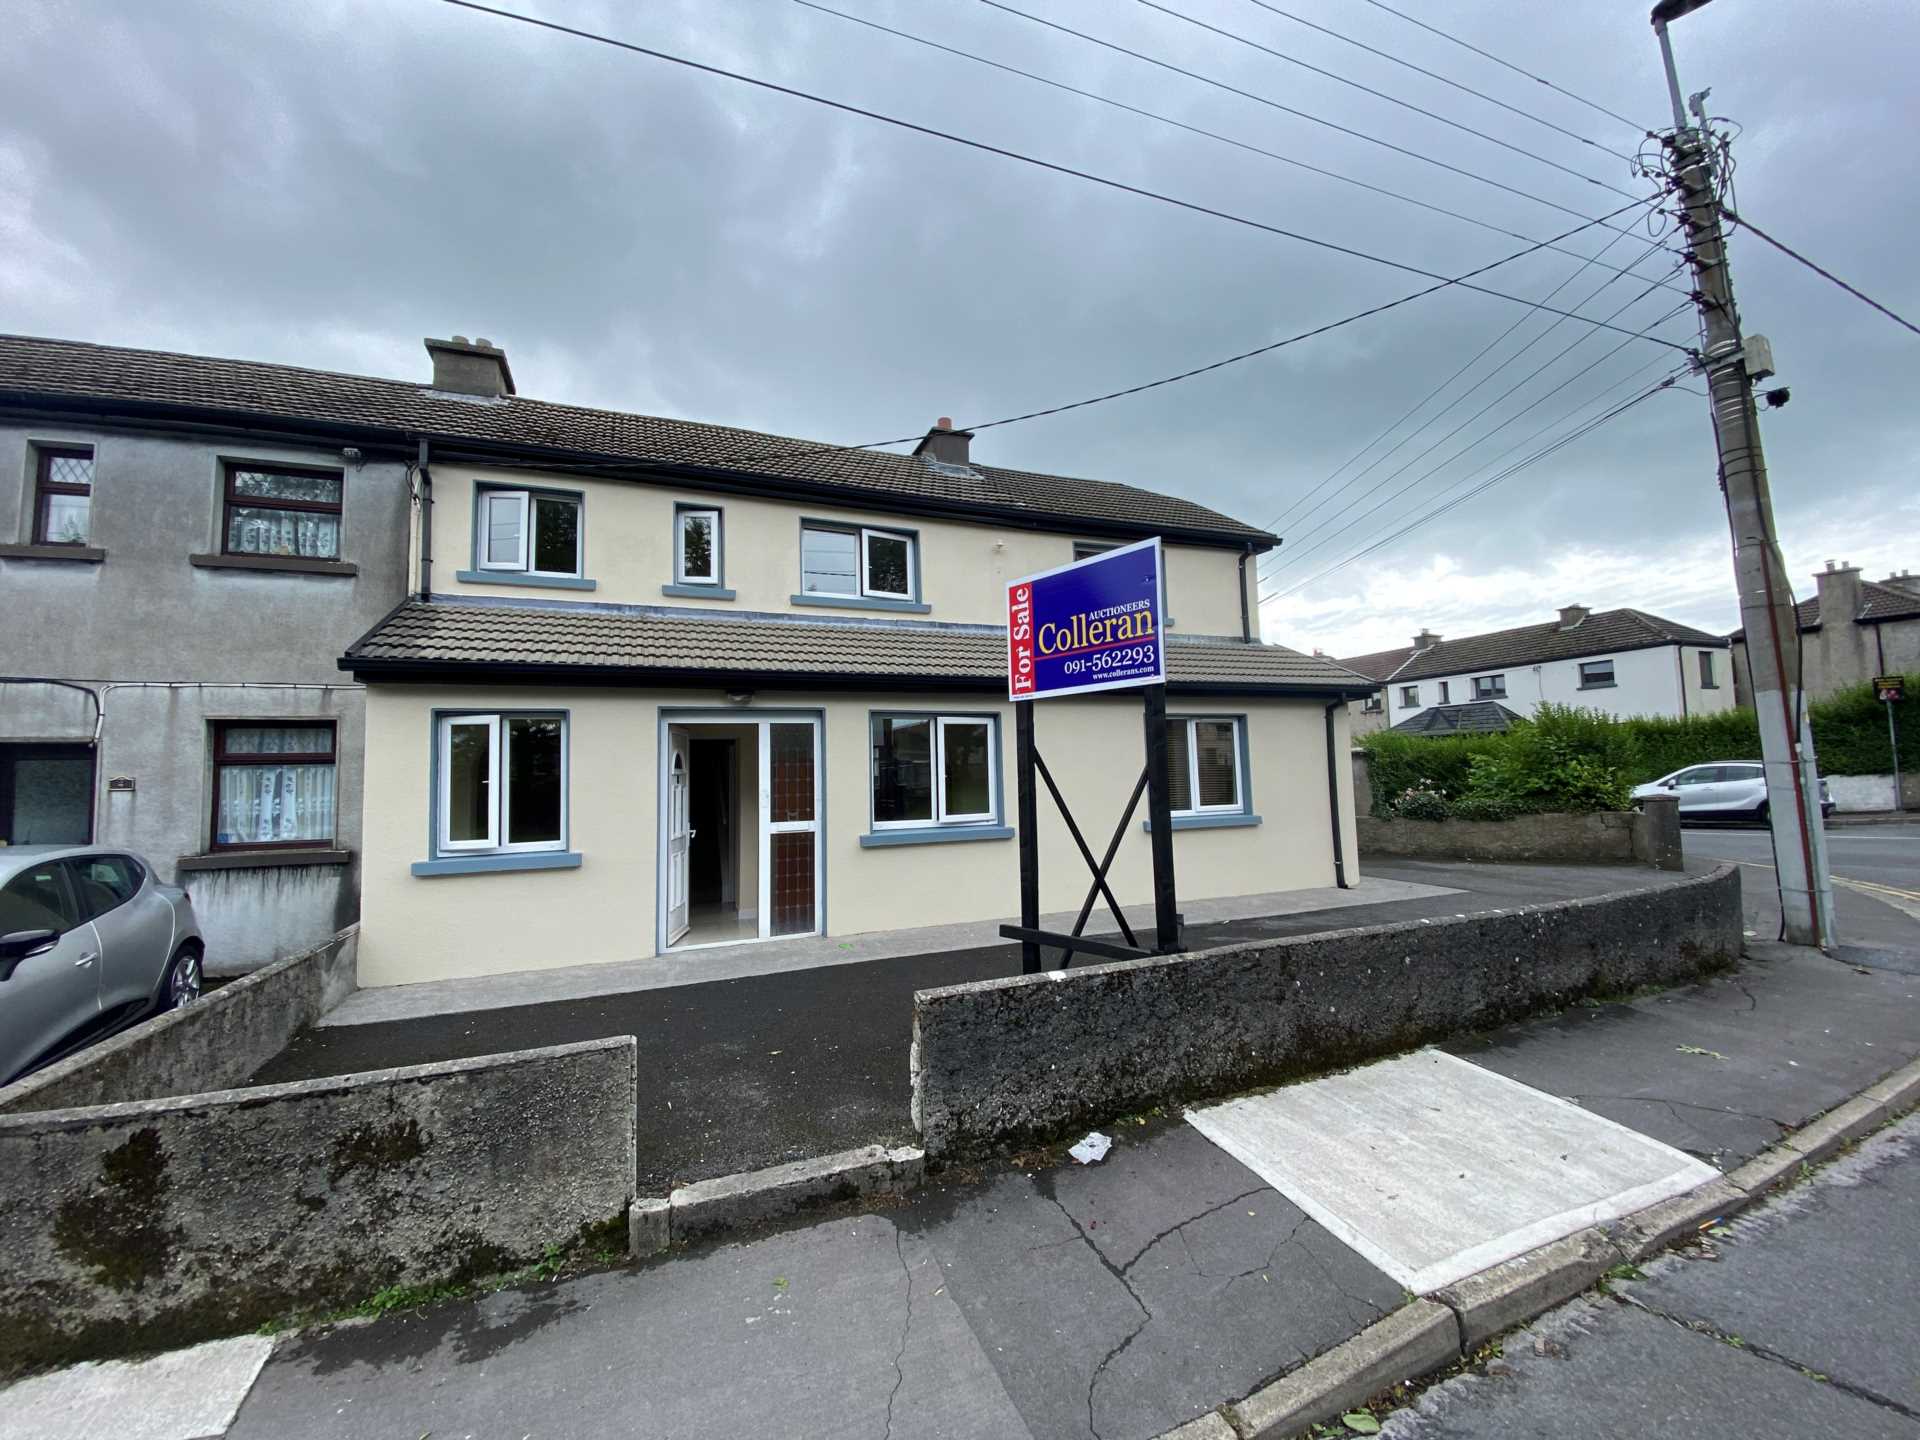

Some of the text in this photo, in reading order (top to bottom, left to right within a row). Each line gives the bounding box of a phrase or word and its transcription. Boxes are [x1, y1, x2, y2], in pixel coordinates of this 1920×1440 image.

[1012, 588, 1029, 640] Sale
[1088, 599, 1150, 621] AUCTIONEERS
[1038, 610, 1154, 654] Colleran
[1015, 646, 1031, 690] For
[1064, 645, 1155, 674] 091-562293
[1092, 665, 1154, 680] www.collerans.com
